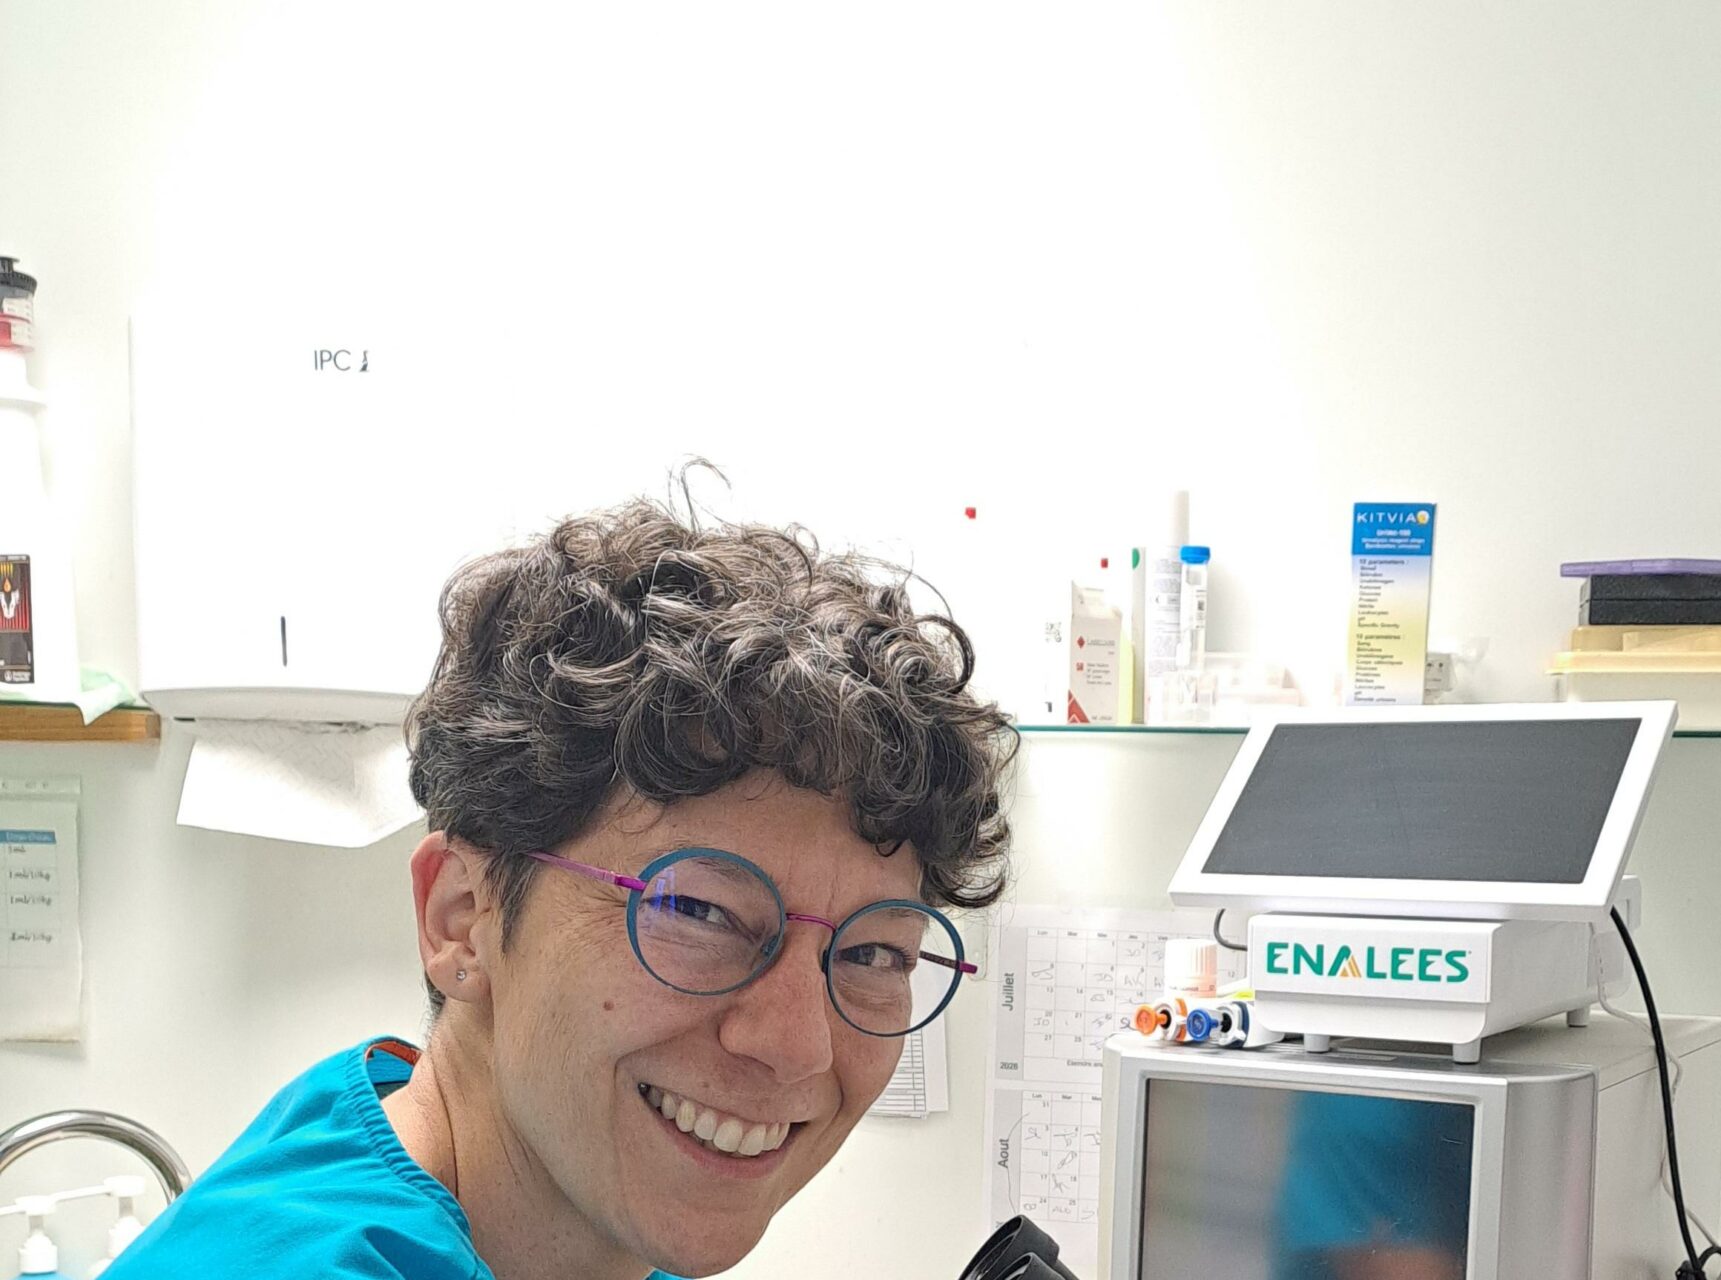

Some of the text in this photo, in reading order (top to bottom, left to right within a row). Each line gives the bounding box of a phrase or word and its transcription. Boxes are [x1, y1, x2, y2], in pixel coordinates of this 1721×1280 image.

[314, 349, 352, 371] IPC
[1356, 511, 1417, 523] KITVIA
[1266, 941, 1470, 983] ENALEES
[1001, 972, 1015, 1012] Juillet
